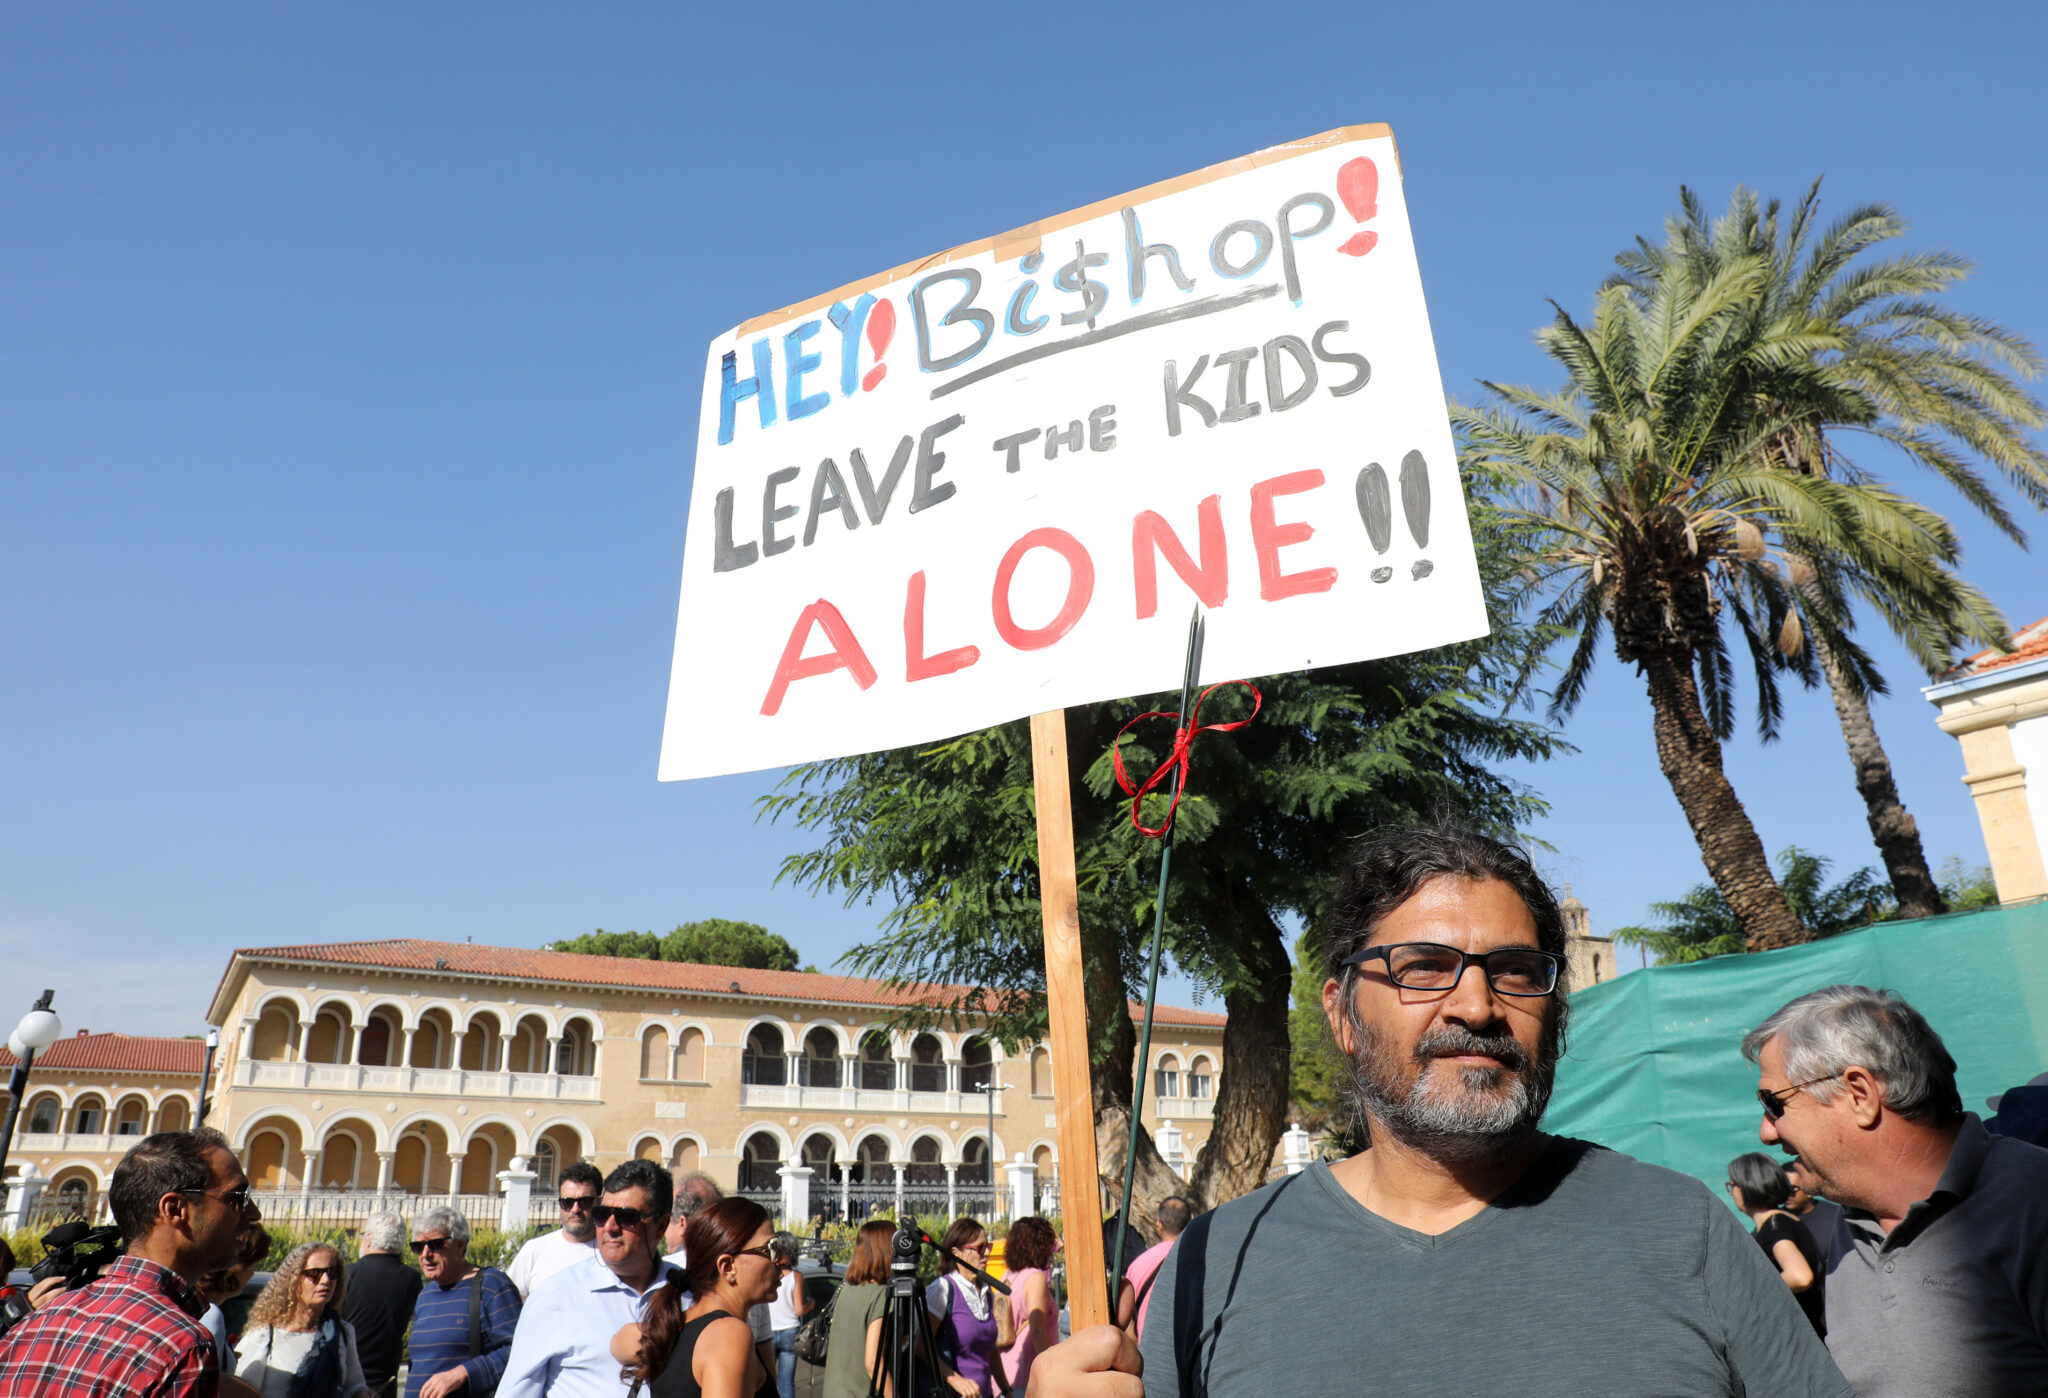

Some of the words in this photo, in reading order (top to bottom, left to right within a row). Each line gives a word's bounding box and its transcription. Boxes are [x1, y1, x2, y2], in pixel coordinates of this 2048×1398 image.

[713, 413, 966, 573] LEAVE
[992, 404, 1117, 474] THE
[1163, 320, 1371, 437] KIDS
[717, 291, 897, 446] HEY!
